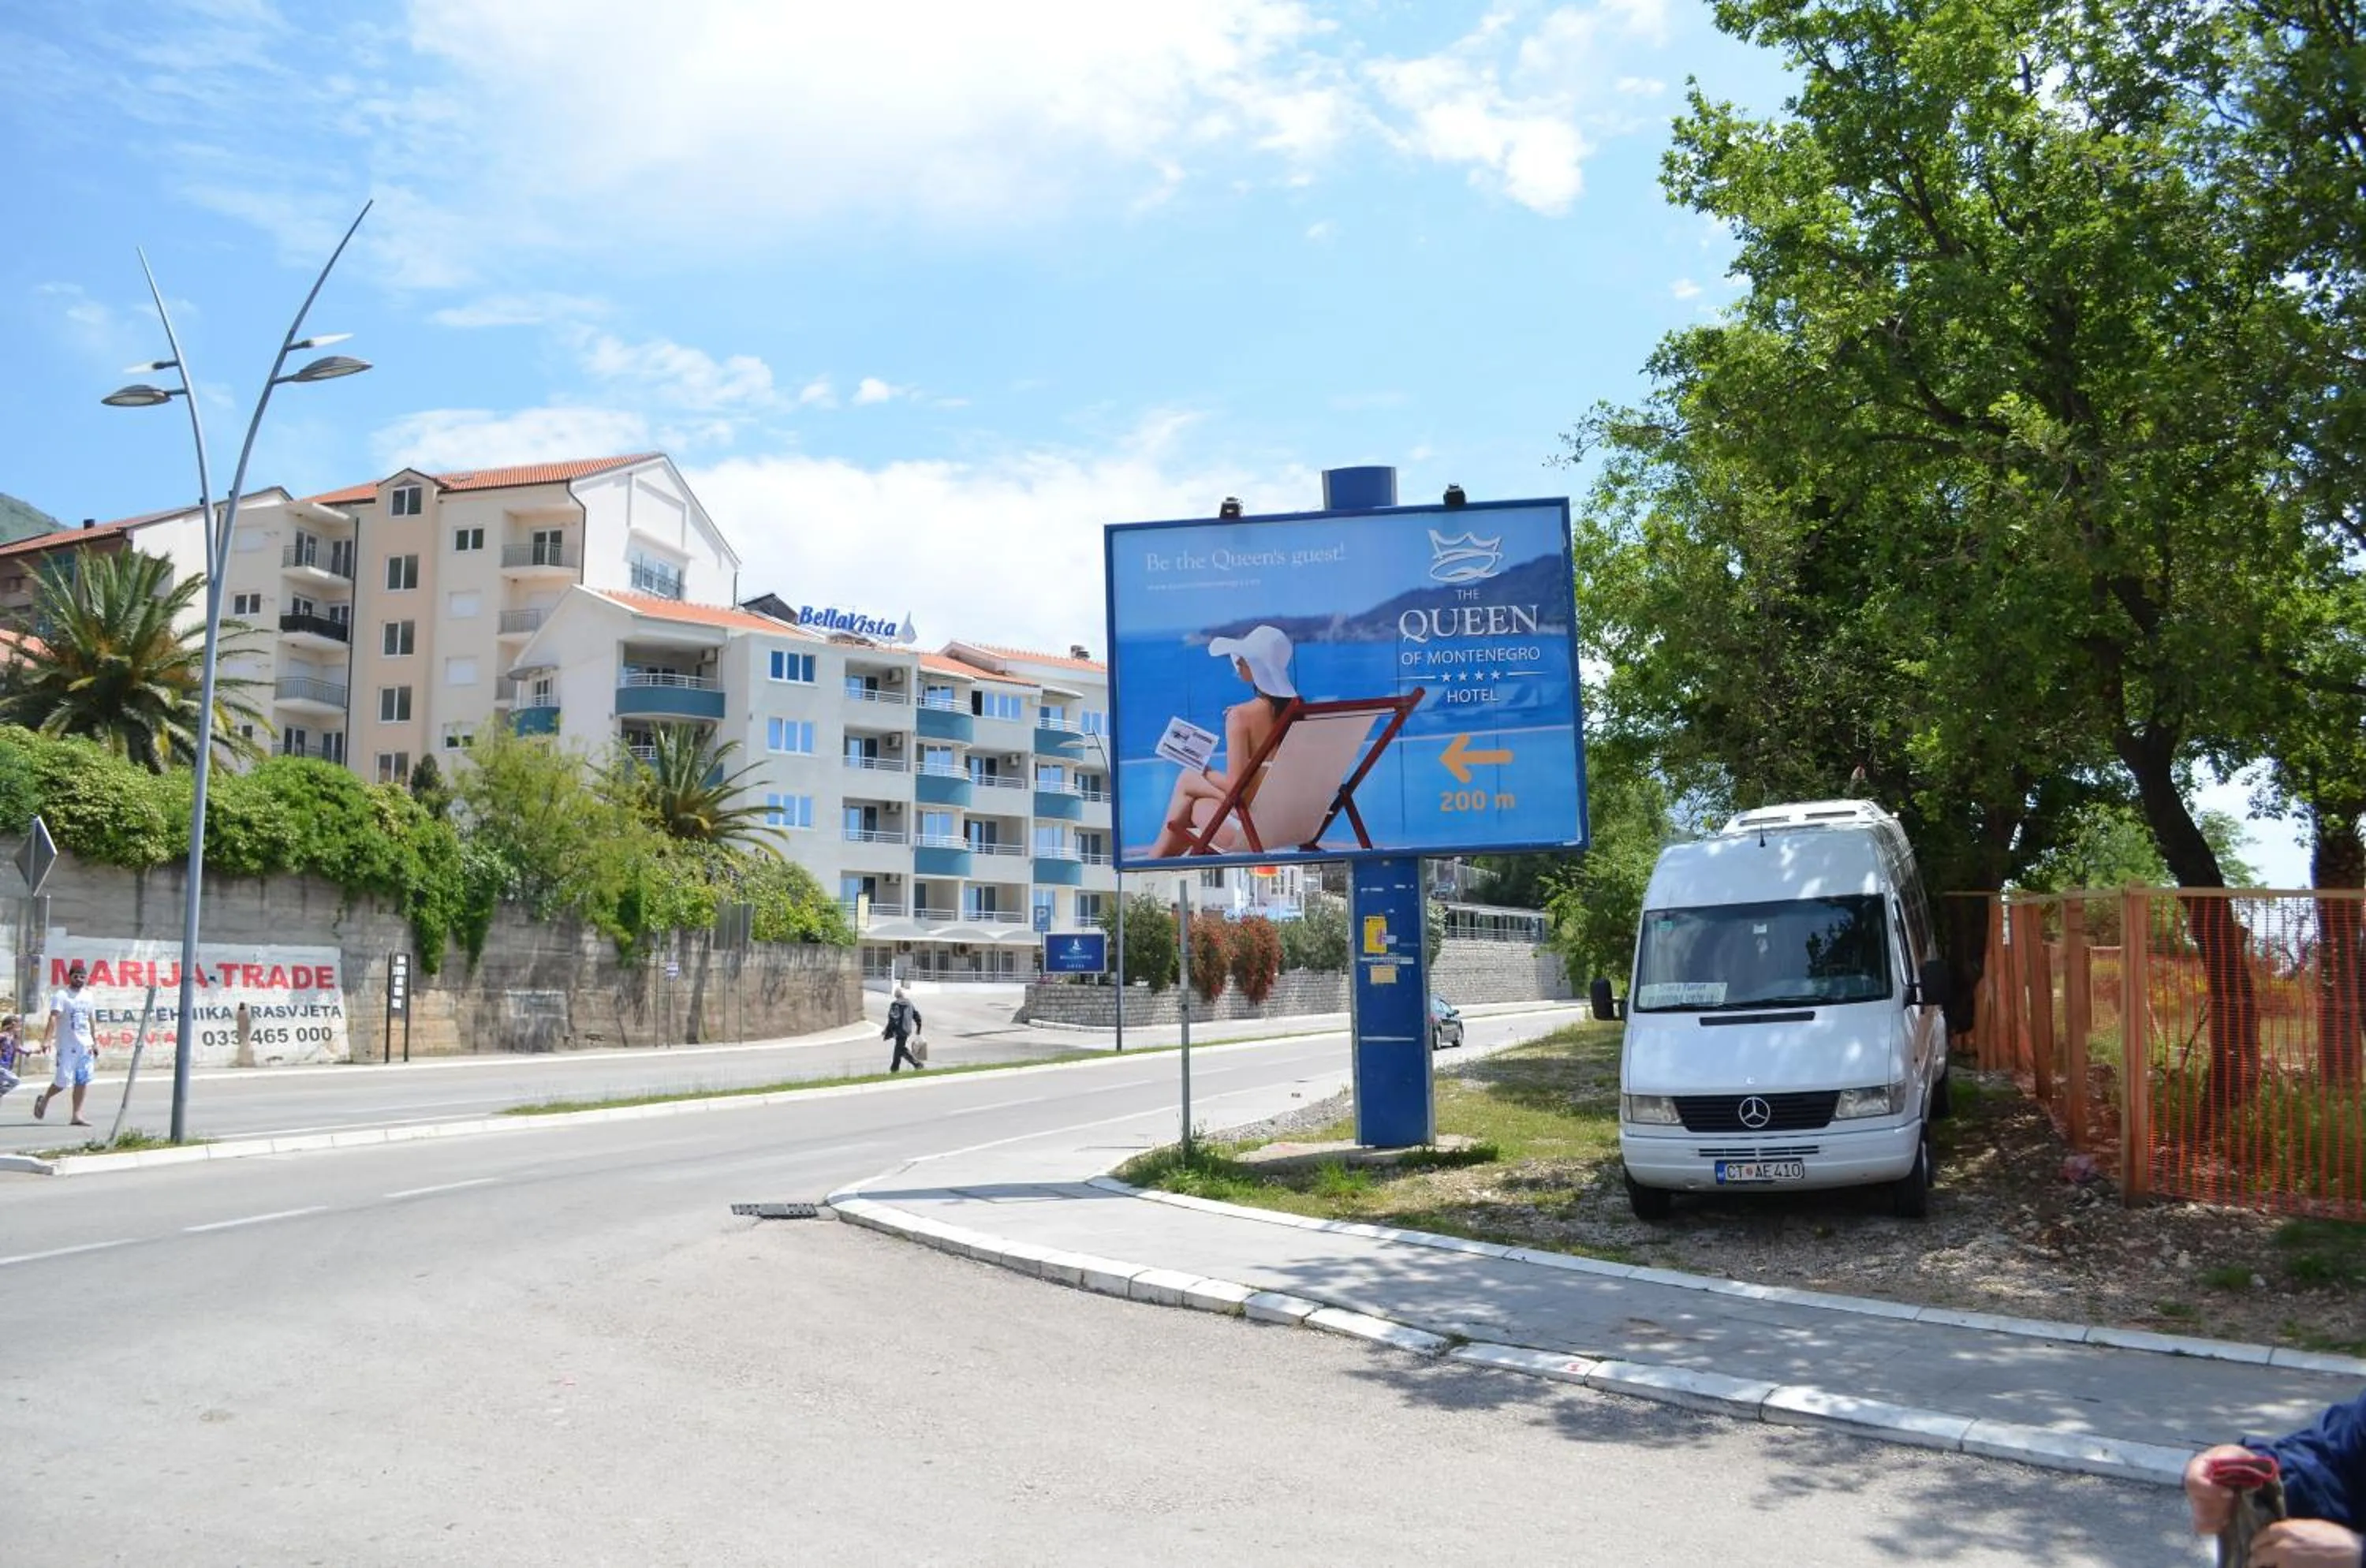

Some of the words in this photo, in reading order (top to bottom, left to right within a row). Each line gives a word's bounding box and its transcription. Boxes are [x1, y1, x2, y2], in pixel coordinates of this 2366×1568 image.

[1146, 553, 1170, 571] Be
[1176, 550, 1207, 570] the
[1212, 547, 1286, 570] Queen's
[1291, 540, 1345, 569] guest!
[1456, 589, 1481, 600] THE
[800, 606, 897, 637] BellaVista
[1398, 604, 1539, 644] QUEEN
[1401, 652, 1422, 666] OF
[1427, 646, 1540, 665] MONTENEGRO
[1447, 688, 1500, 704] HOTEL
[1439, 791, 1487, 812] 200
[1495, 793, 1515, 809] m
[1036, 908, 1048, 923] P
[216, 962, 335, 989] TRADE
[250, 1004, 342, 1020] RASVJETA
[202, 1029, 241, 1047] 033
[250, 1028, 289, 1045] 465
[296, 1026, 333, 1042] 000
[1755, 1163, 1802, 1178] AE410
